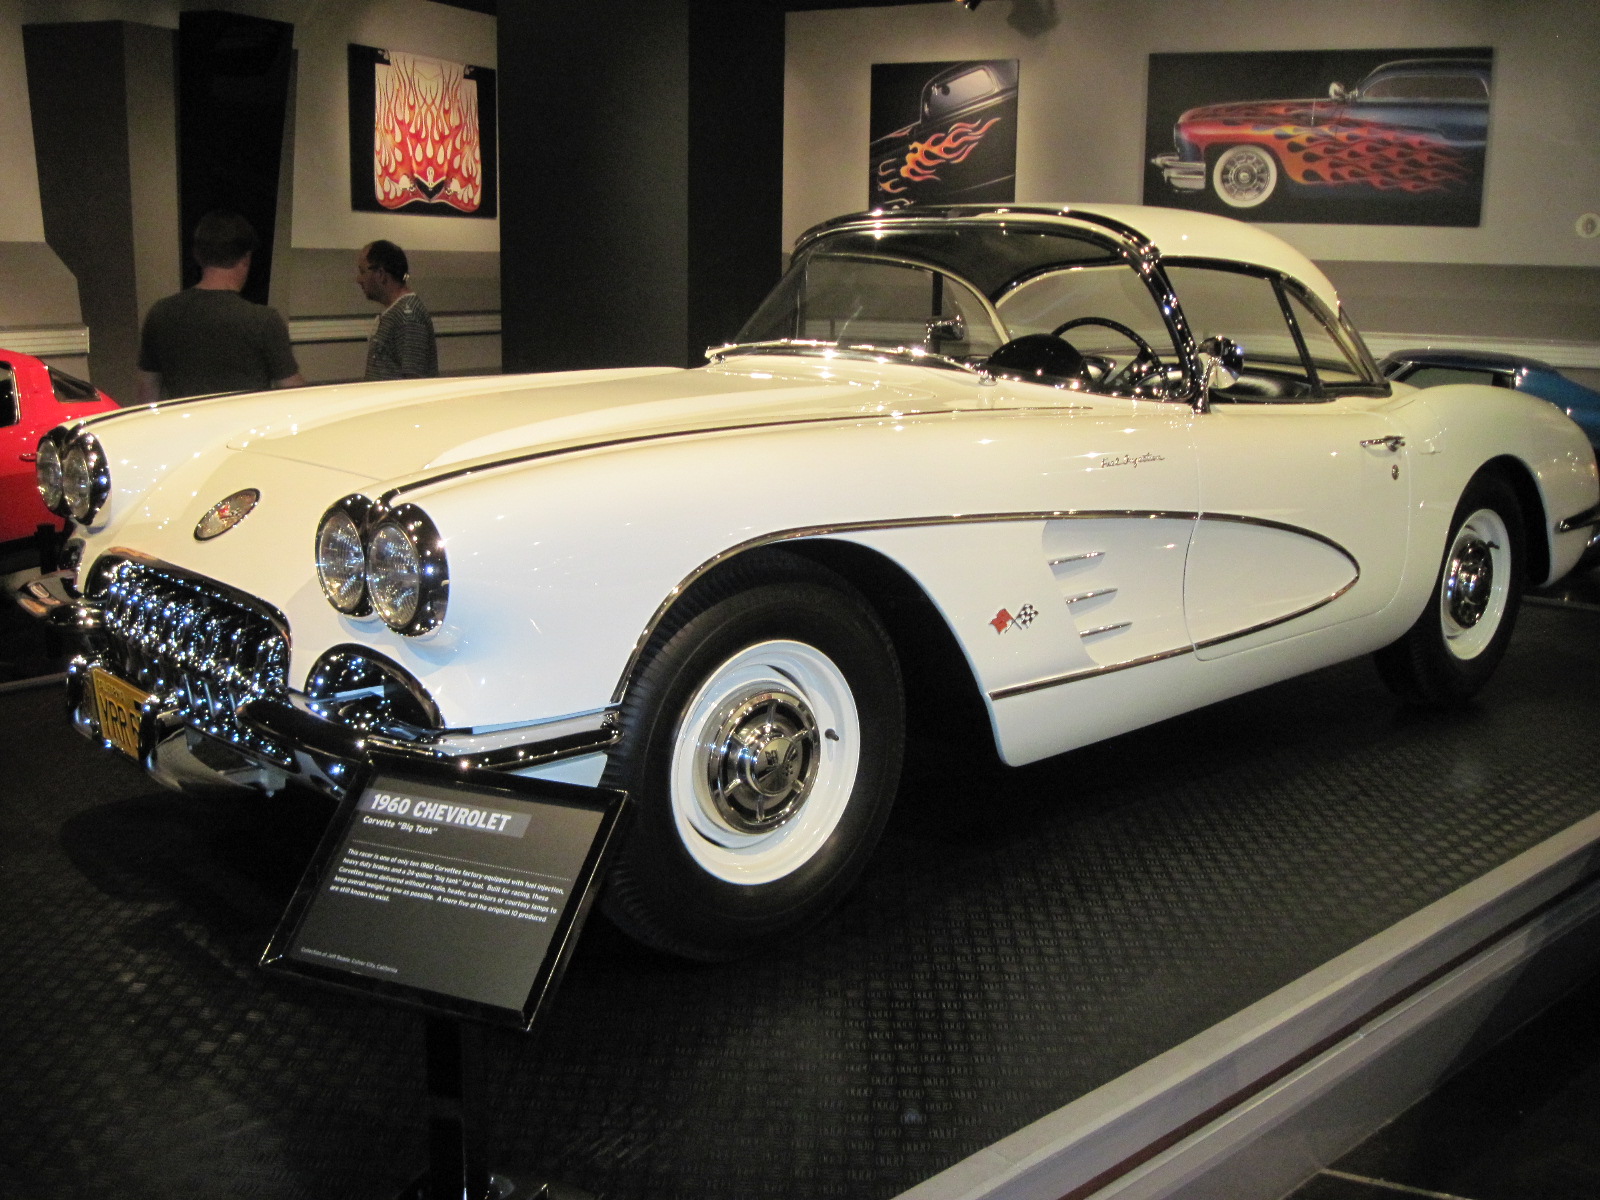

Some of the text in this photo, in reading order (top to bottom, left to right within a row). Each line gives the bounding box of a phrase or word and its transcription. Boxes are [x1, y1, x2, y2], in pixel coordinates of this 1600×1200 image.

[363, 816, 438, 834] Corvette "Big Tank"
[371, 793, 512, 831] 1960 CHEVROLET
[339, 866, 364, 876] Corvettes
[379, 874, 404, 884] delivered
[404, 879, 425, 889] without
[479, 893, 496, 902] visors
[505, 898, 530, 909] courtesy
[531, 903, 549, 913] lamps
[343, 858, 359, 866] heavy
[372, 862, 390, 871] brakes
[532, 892, 549, 901] these
[350, 888, 368, 896] known
[420, 861, 434, 870] 1960
[435, 864, 461, 875] Corvettes
[537, 884, 564, 894] injection,
[334, 875, 347, 883] keep
[367, 882, 384, 891] weight
[488, 906, 510, 915] original
[518, 911, 547, 922] produced
